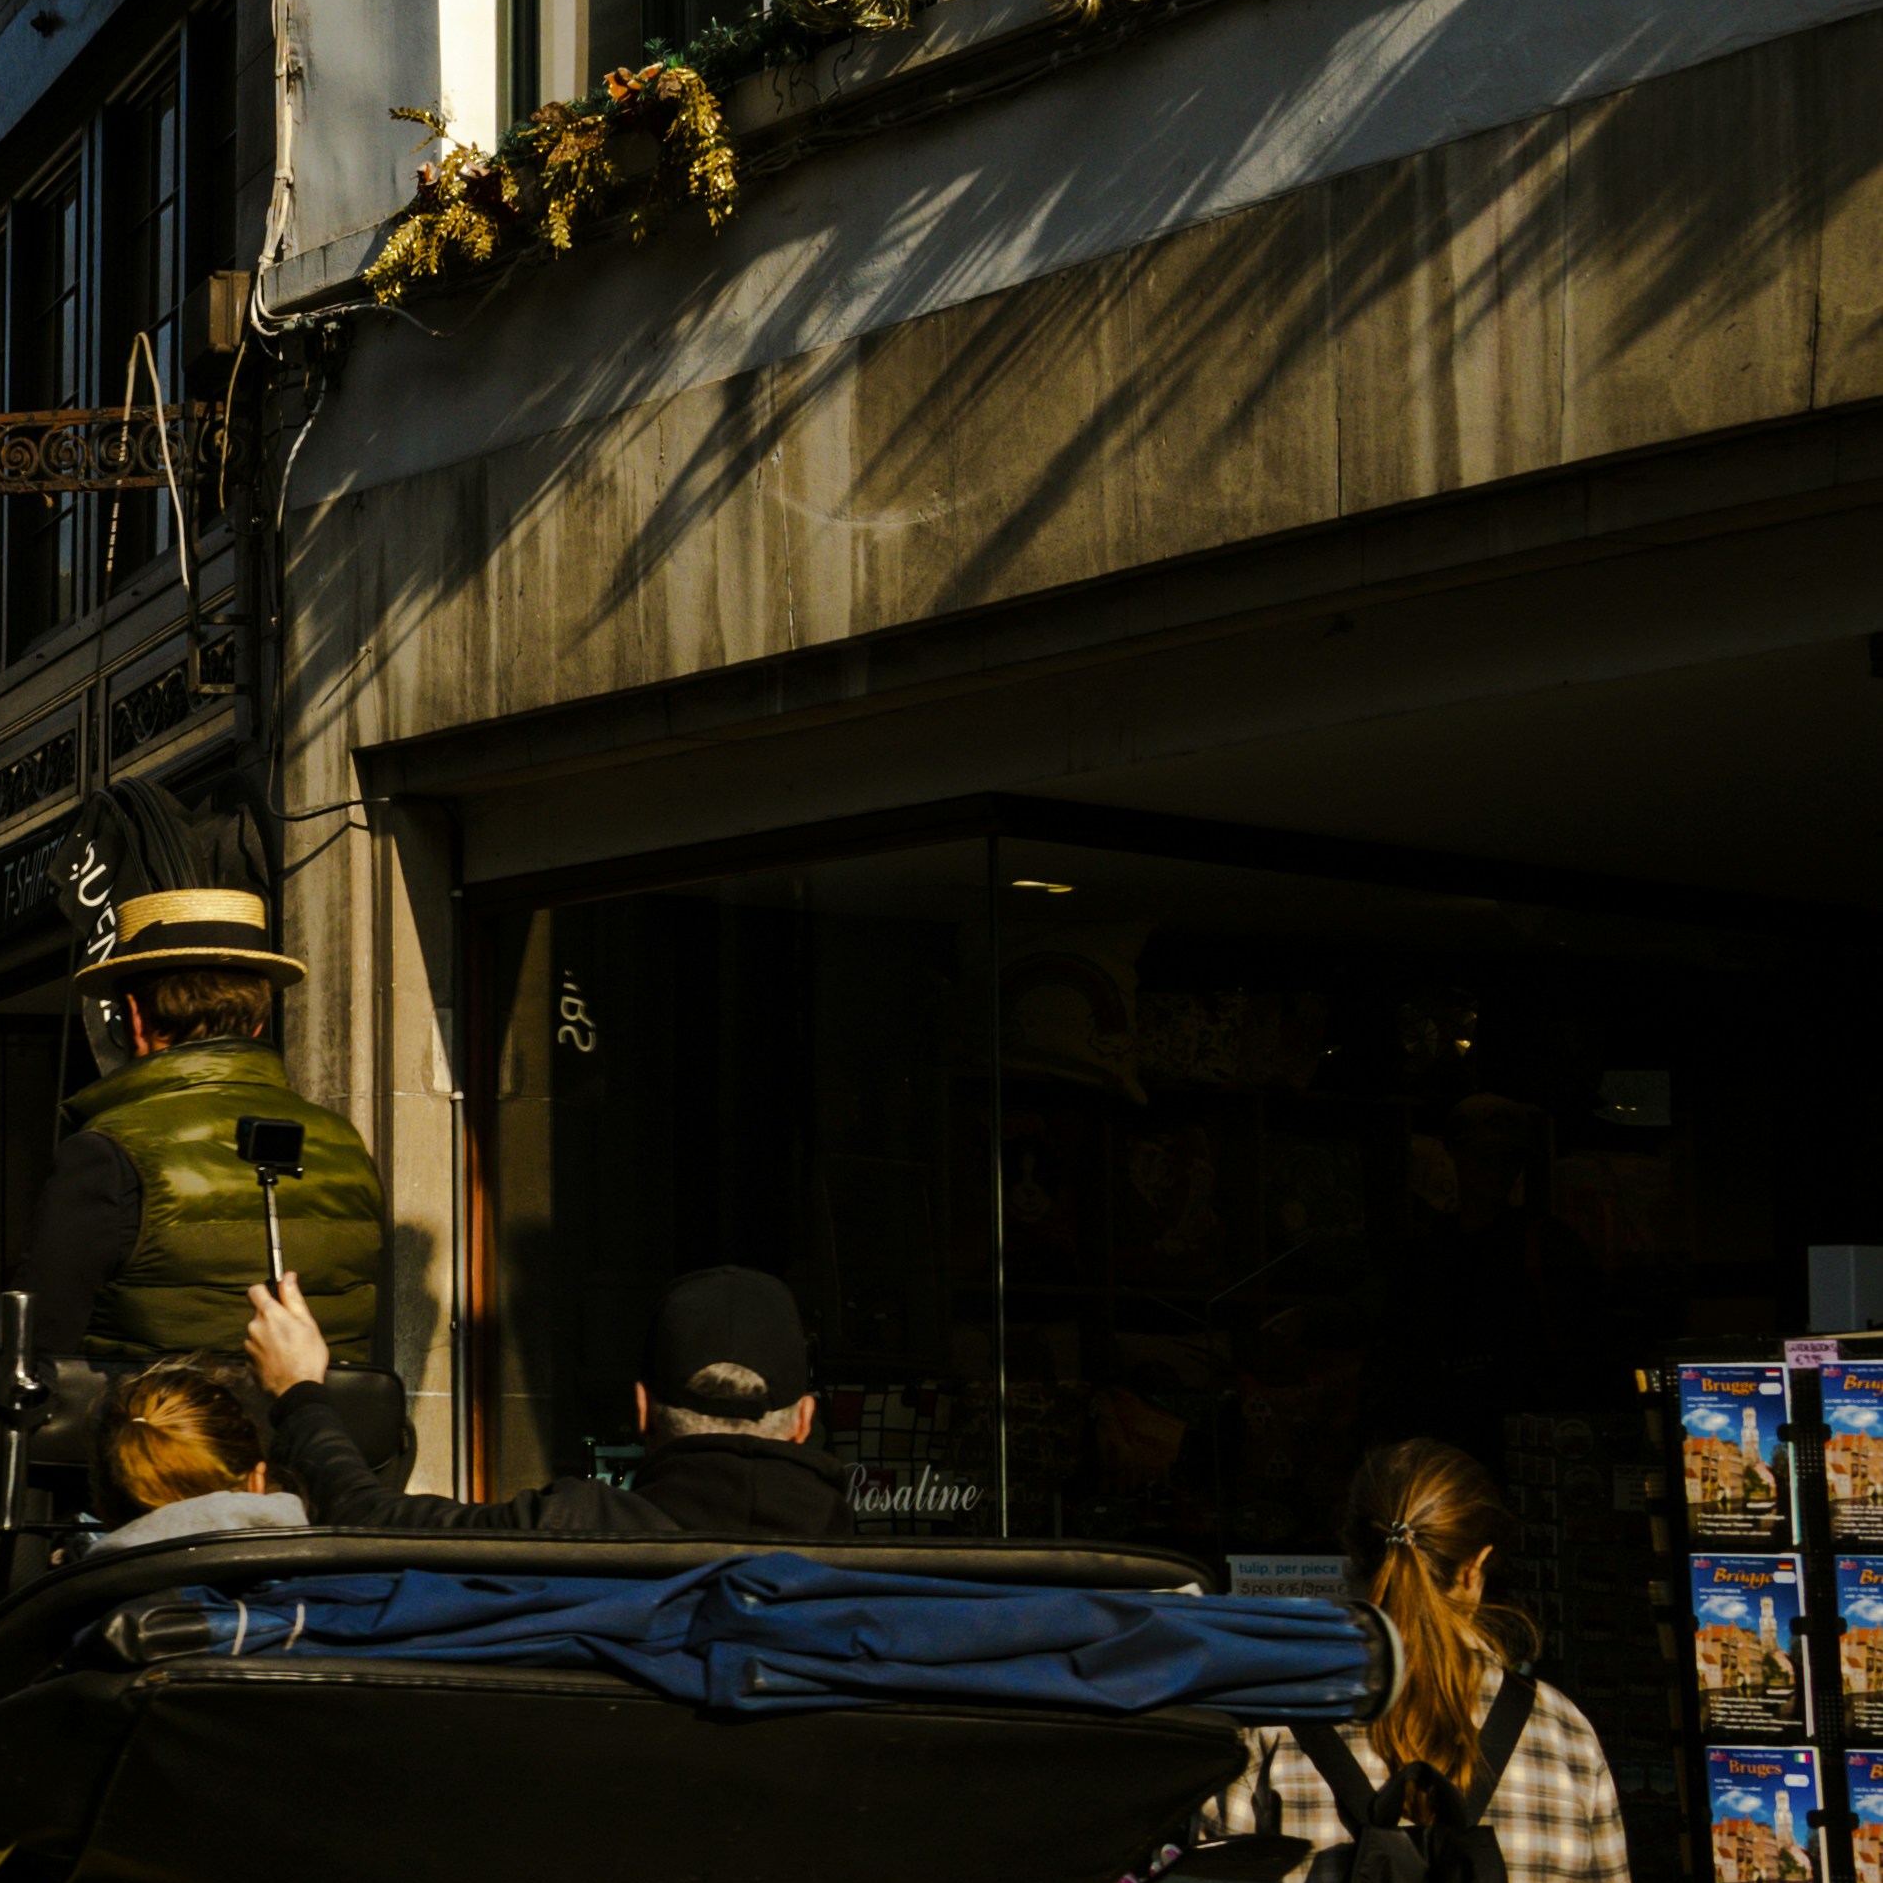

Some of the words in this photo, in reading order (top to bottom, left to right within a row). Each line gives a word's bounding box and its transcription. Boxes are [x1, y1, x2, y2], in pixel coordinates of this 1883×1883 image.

[1701, 1378, 1757, 1396] Brugge
[845, 1462, 984, 1512] Rosaline
[1276, 1564, 1297, 1576] per
[1301, 1562, 1338, 1575] piece
[1728, 1759, 1783, 1779] Bruges
